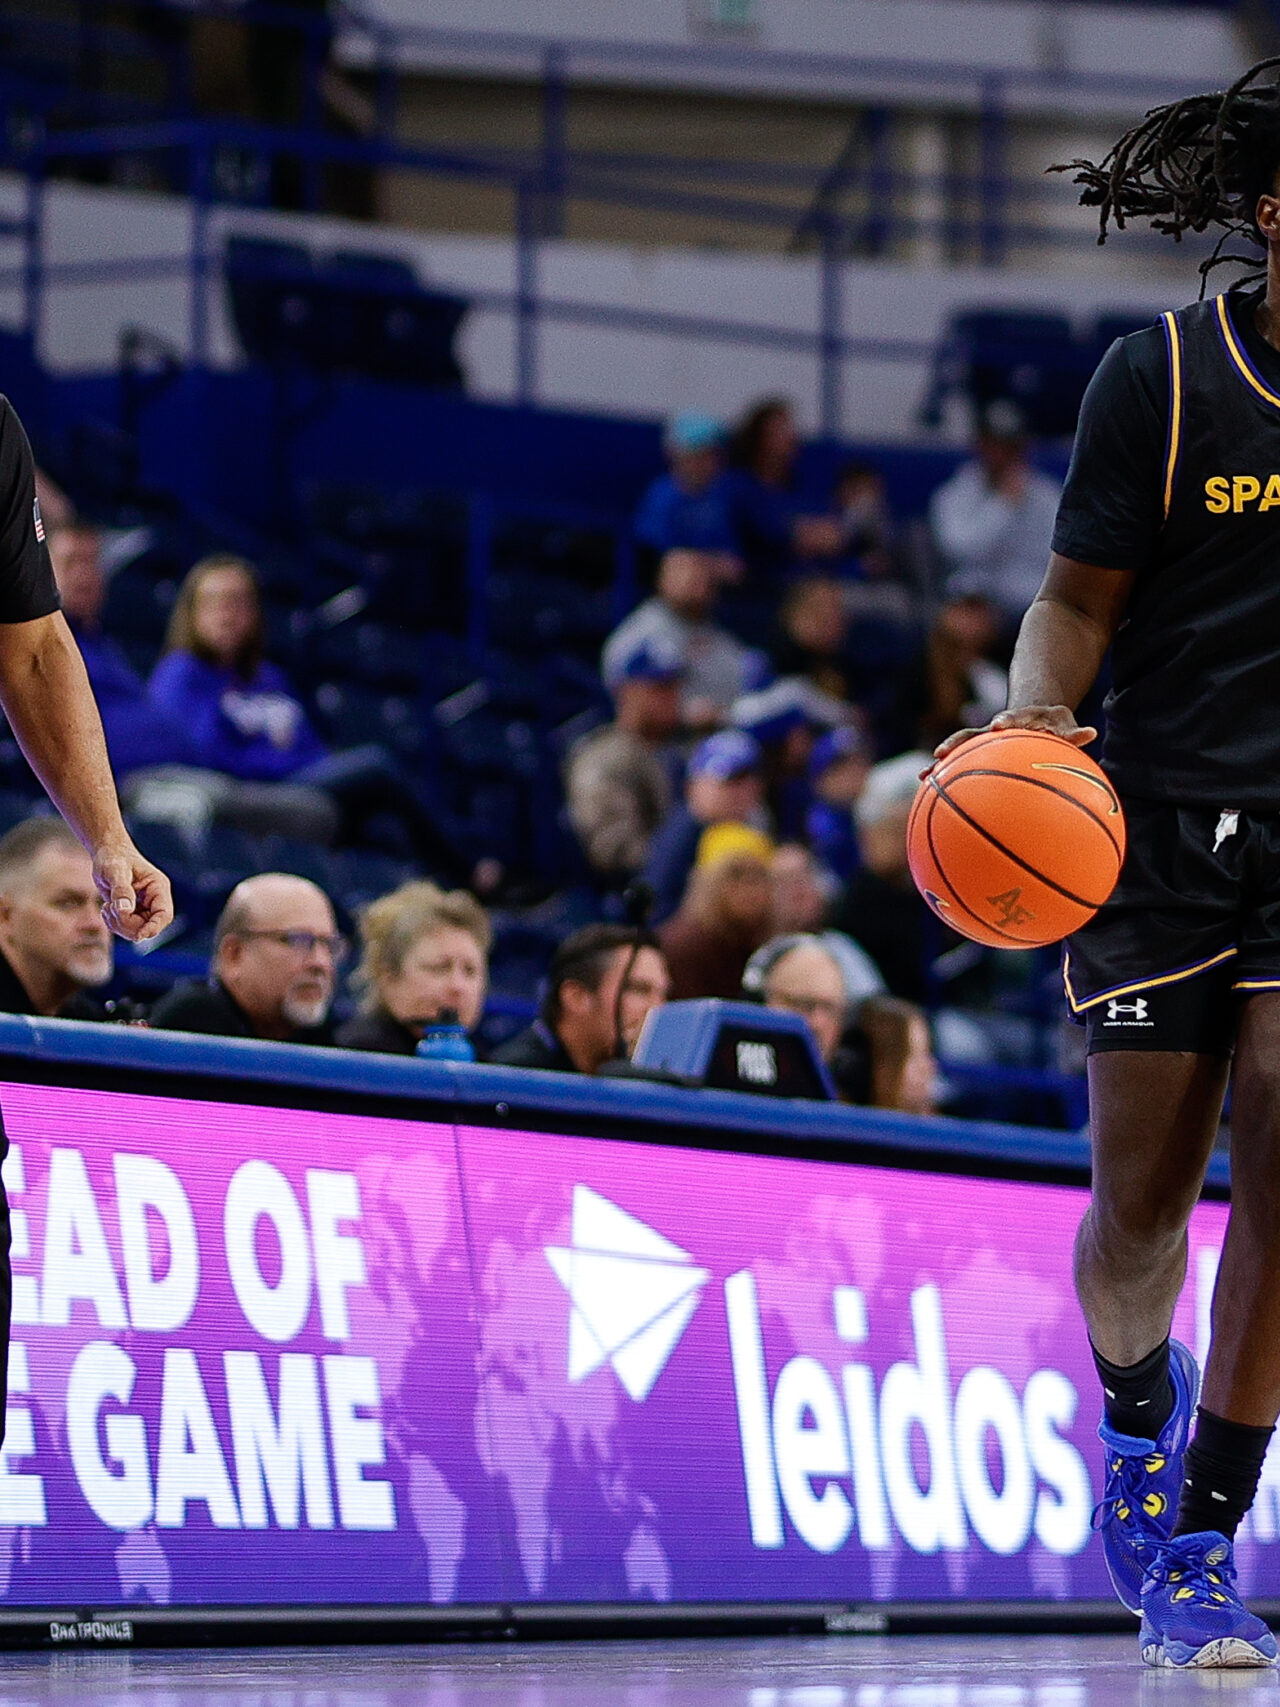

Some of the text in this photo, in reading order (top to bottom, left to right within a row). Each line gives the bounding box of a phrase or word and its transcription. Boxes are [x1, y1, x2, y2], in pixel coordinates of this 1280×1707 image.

[225, 1160, 366, 1342] OF
[66, 1341, 398, 1532] GAME
[724, 1269, 1093, 1555] leidos
